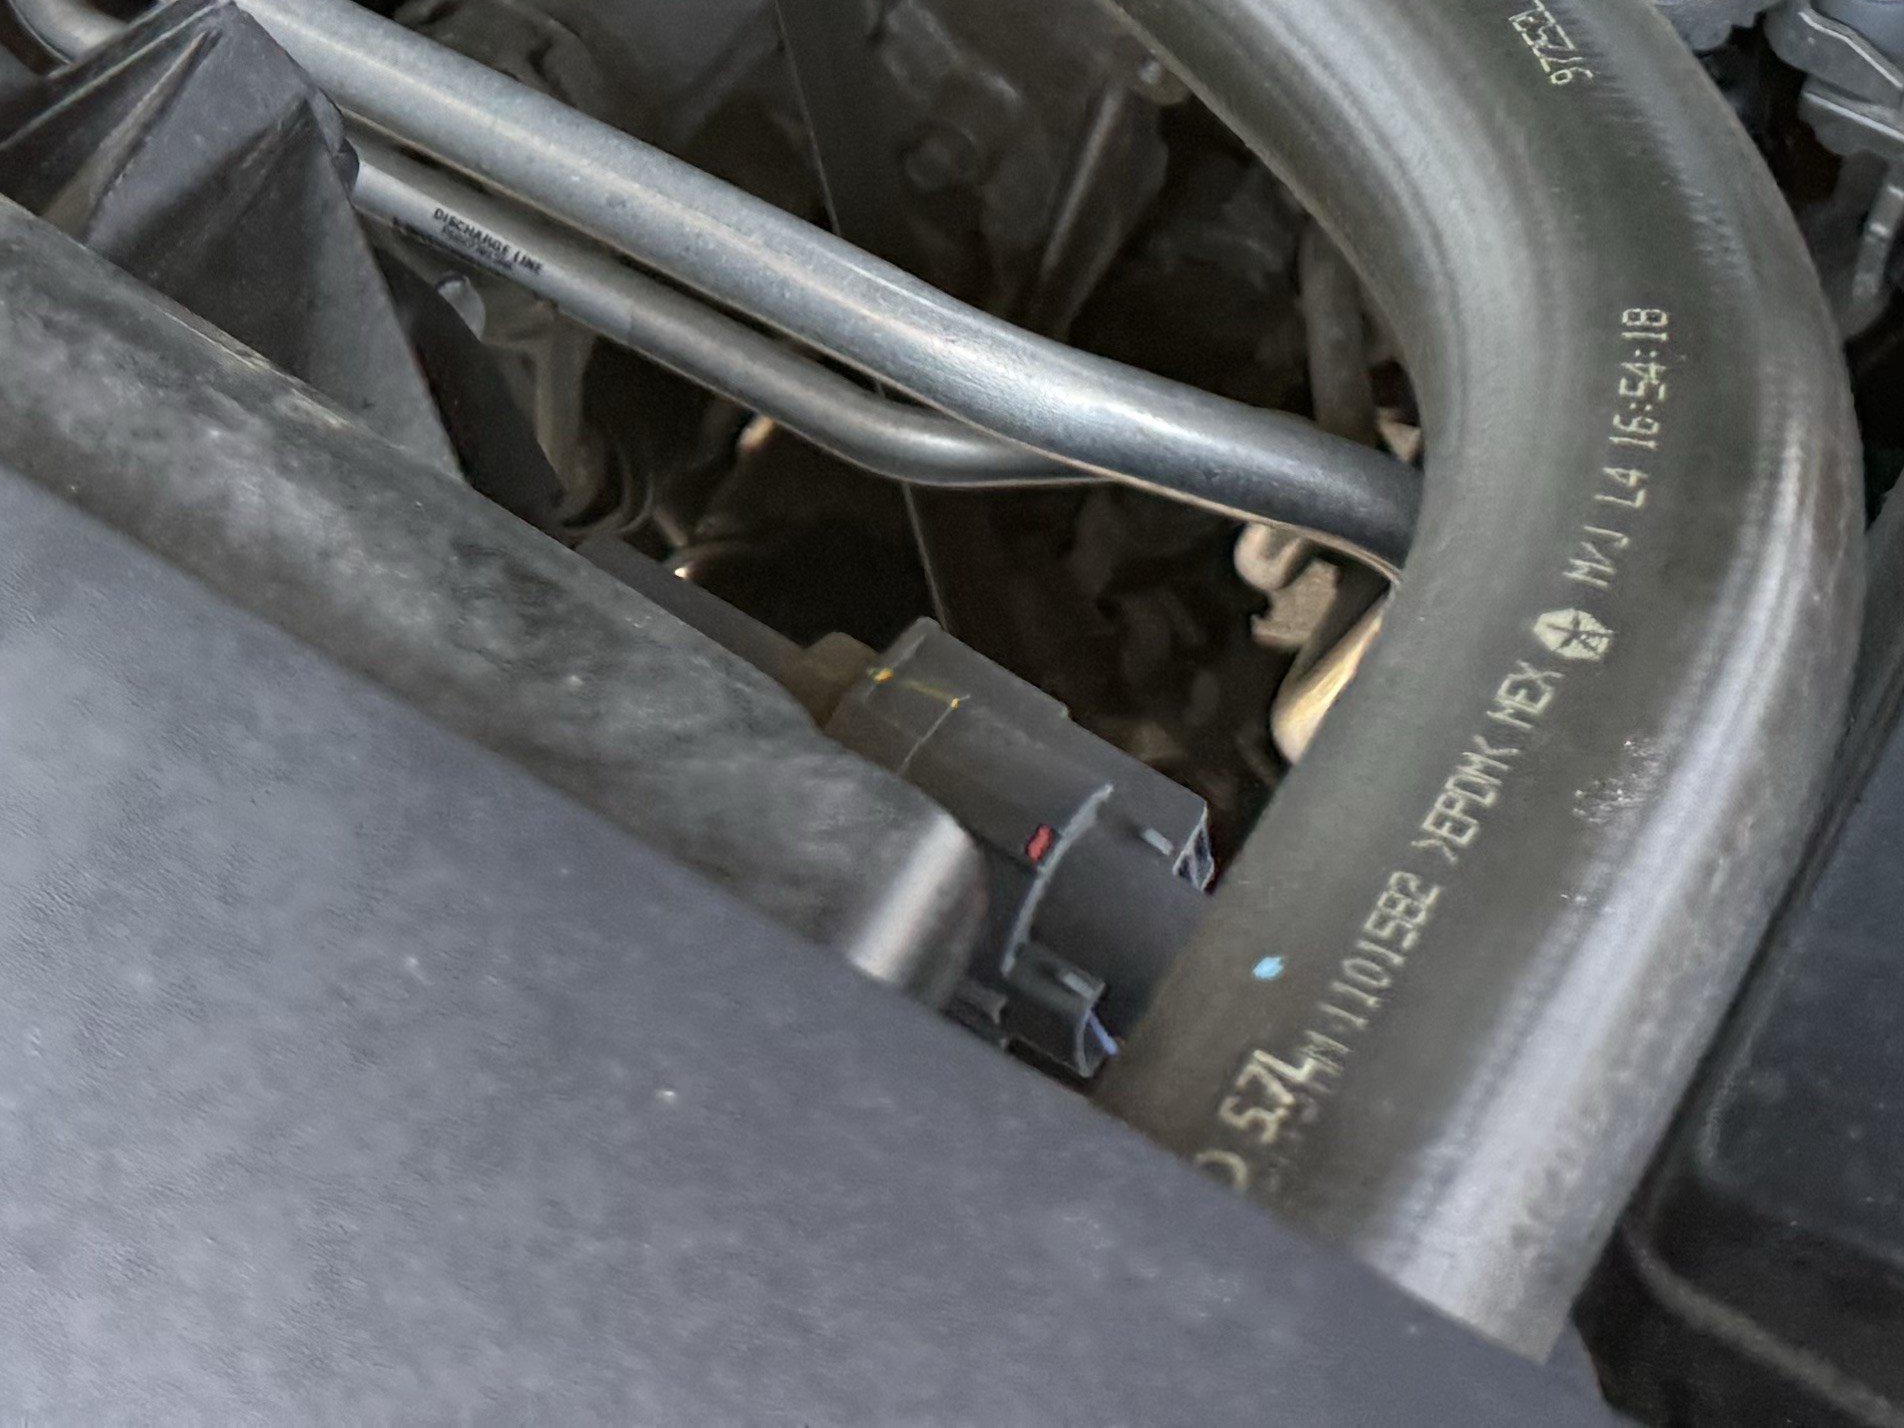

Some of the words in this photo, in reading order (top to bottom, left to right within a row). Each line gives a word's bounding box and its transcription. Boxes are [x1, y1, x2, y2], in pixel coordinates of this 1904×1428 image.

[433, 207, 512, 254] DISCHARGE
[513, 251, 544, 276] LINE
[1608, 308, 1669, 453] 16:54:18
[1595, 458, 1653, 512] L4
[1489, 657, 1565, 731] MEX
[1316, 864, 1443, 1031] 1101582
